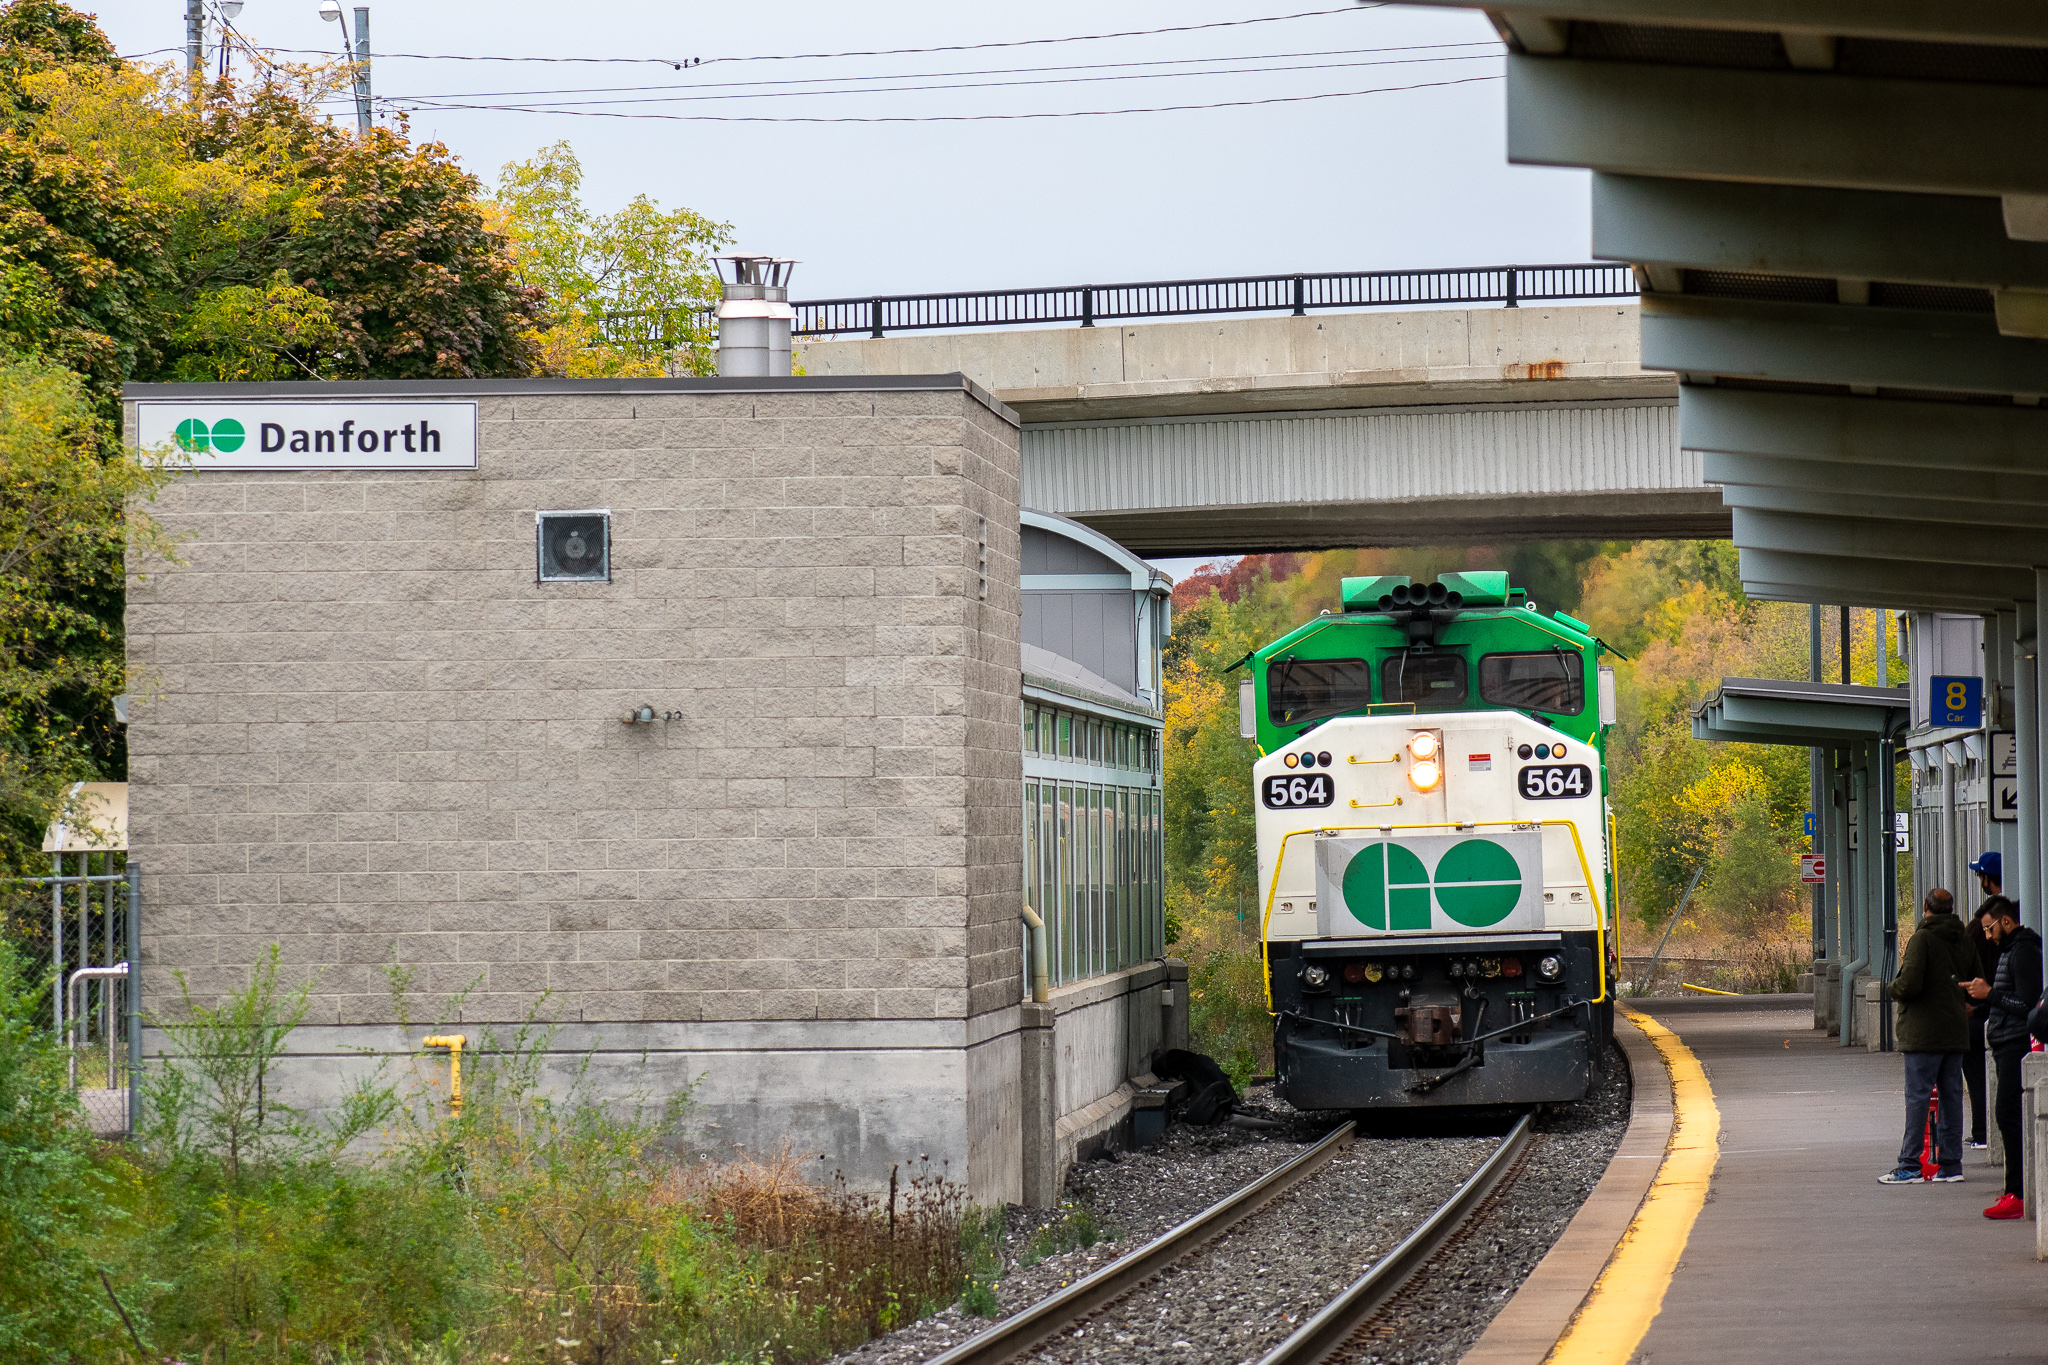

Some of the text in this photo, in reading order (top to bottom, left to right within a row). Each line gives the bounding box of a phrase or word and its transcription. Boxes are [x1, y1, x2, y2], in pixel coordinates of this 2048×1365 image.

[260, 419, 442, 453] Danforth
[1945, 682, 1967, 710] 8
[1946, 713, 1965, 722] Car
[1270, 778, 1328, 807] 564
[1526, 768, 1584, 797] 564
[1896, 814, 1902, 822] 2
[1342, 839, 1522, 931] GO
